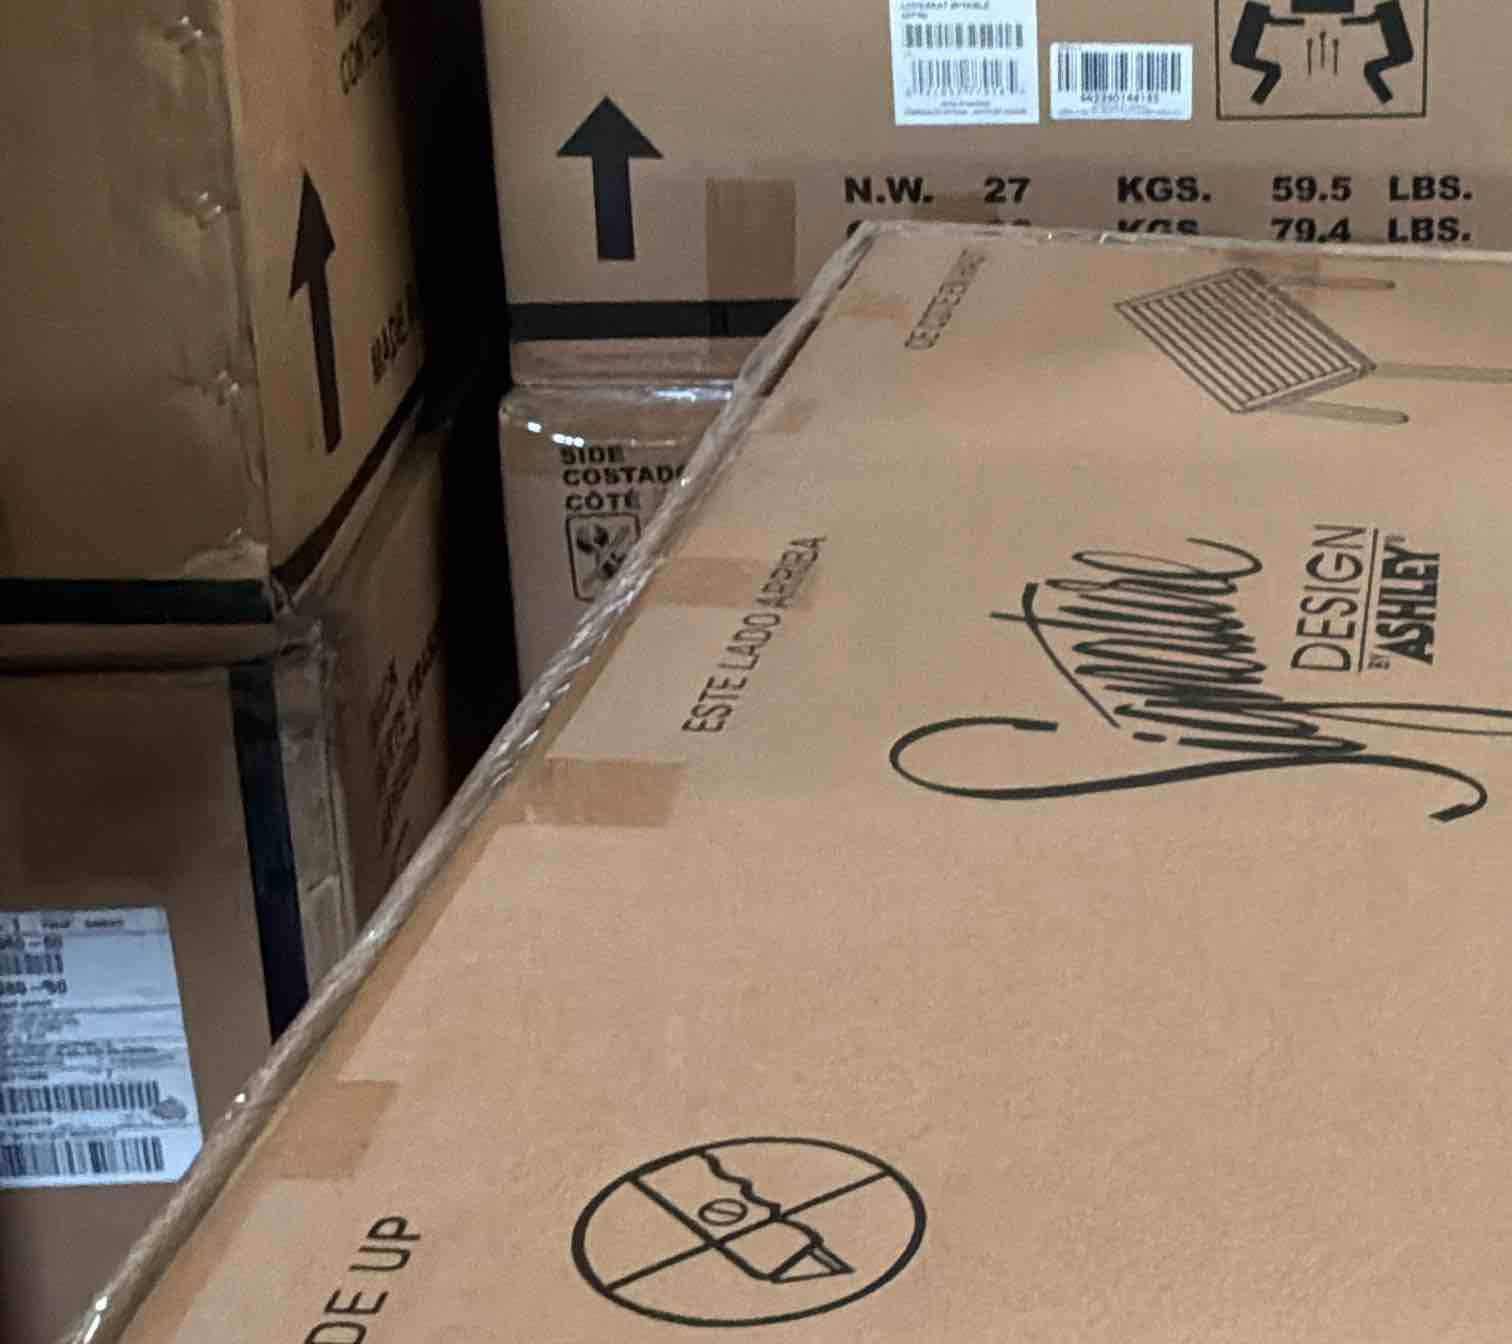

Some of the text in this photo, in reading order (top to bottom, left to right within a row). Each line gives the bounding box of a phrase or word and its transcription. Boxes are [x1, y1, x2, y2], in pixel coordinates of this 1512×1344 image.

[843, 176, 1474, 204] N.W. 27 KGS. 59.5 LBS.
[1272, 218, 1352, 244] 79.4
[1388, 217, 1472, 244] LBS.
[1289, 522, 1369, 674] DESIGN
[1380, 533, 1441, 666] ASHLEY
[681, 675, 748, 734] ESTE
[739, 609, 783, 674] LADO
[359, 1214, 423, 1280] UP
